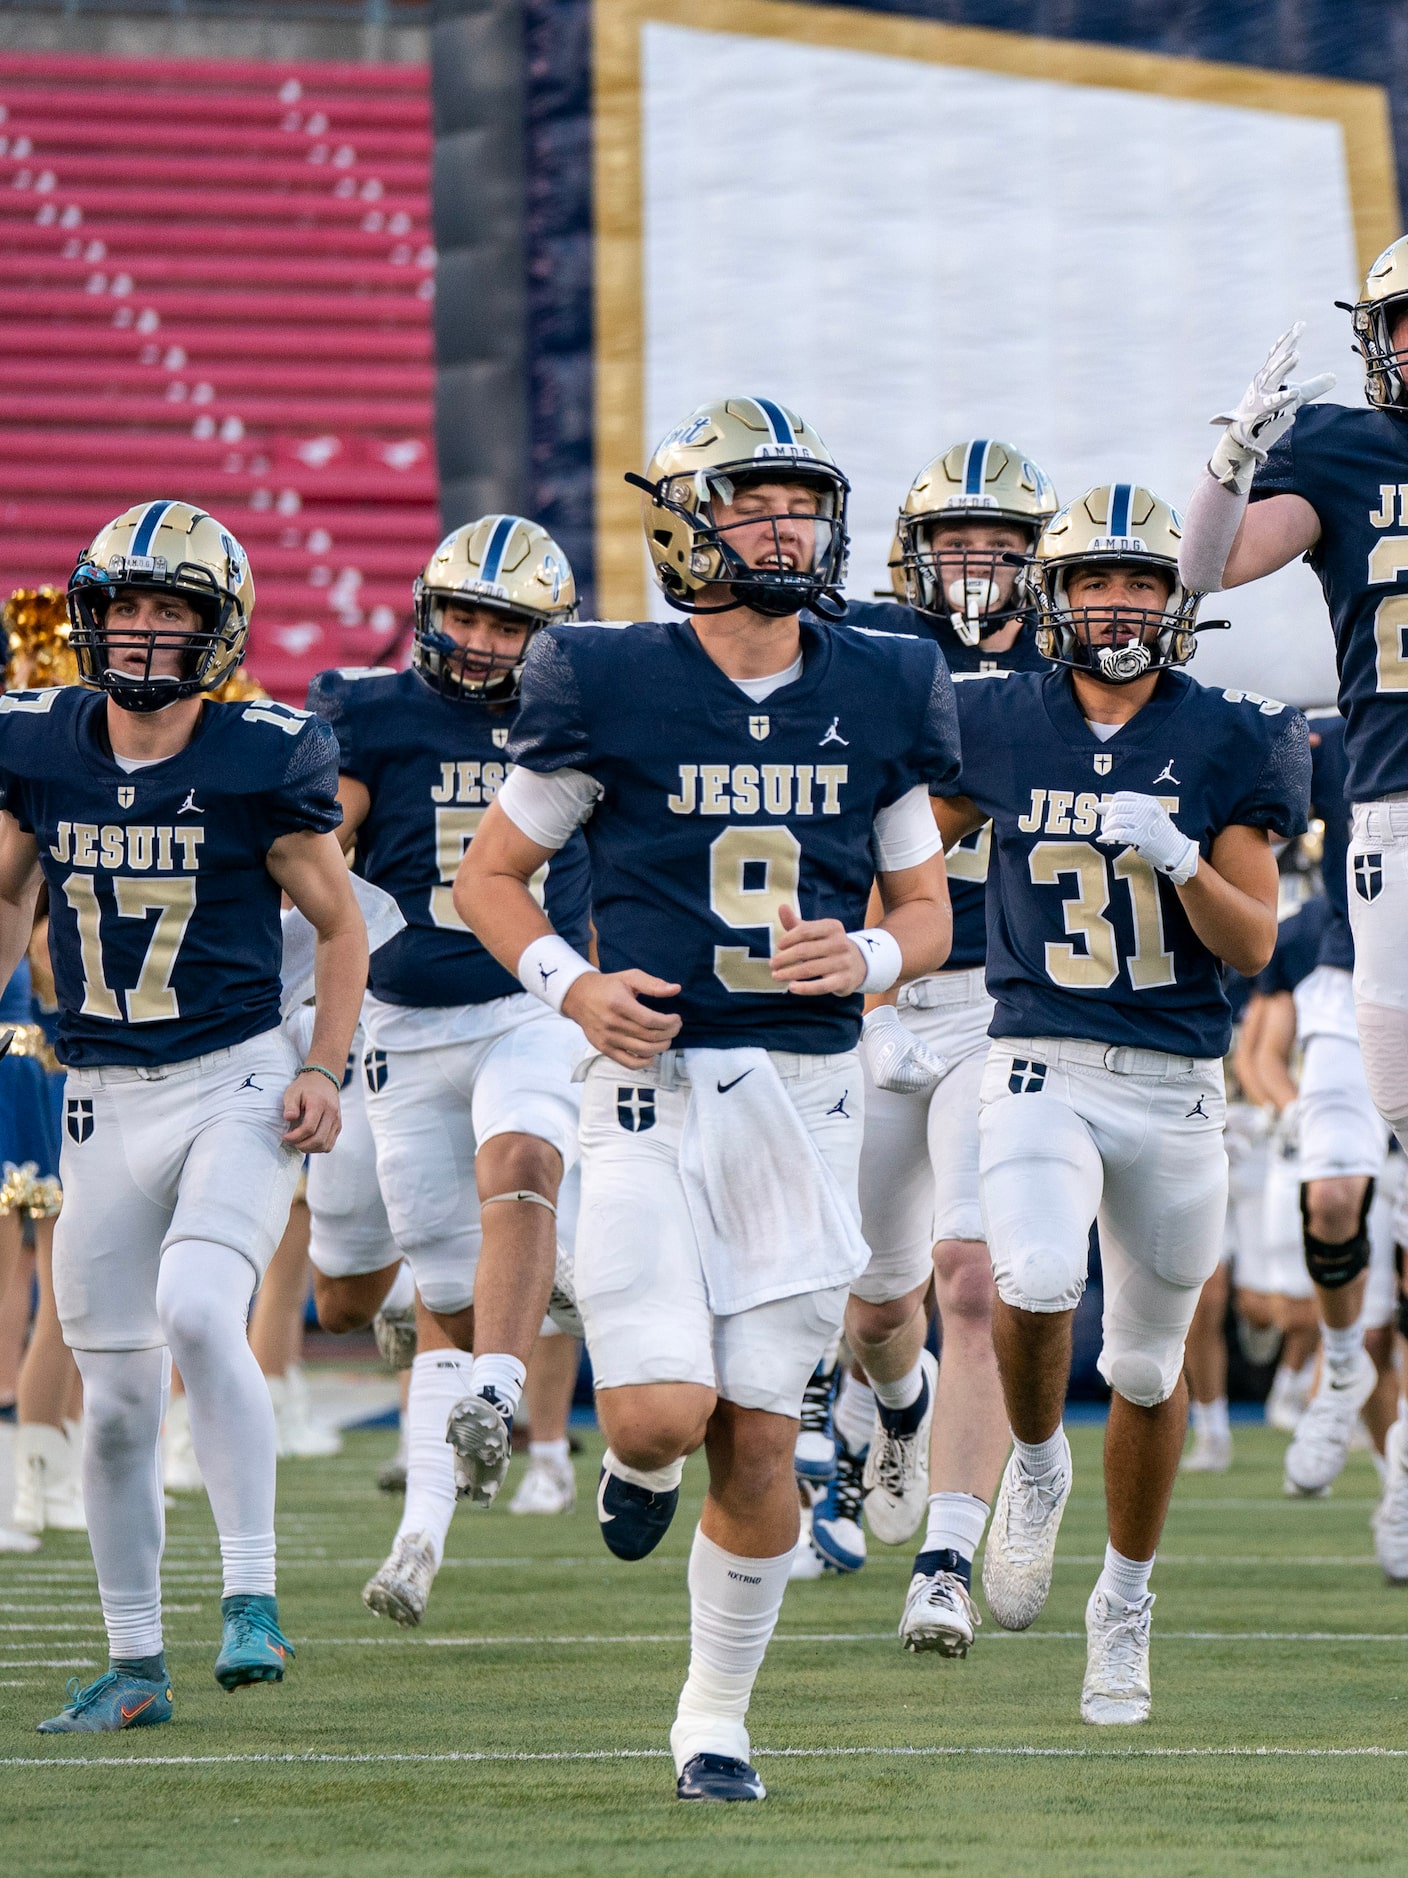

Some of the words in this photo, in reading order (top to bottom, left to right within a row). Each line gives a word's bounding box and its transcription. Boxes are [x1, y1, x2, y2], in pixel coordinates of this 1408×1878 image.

[431, 761, 520, 803] JES
[668, 764, 848, 815] JESUIT
[49, 823, 205, 870] JESUIT
[61, 874, 197, 1023] 17
[709, 825, 801, 993] 9
[1028, 839, 1176, 990] 31
